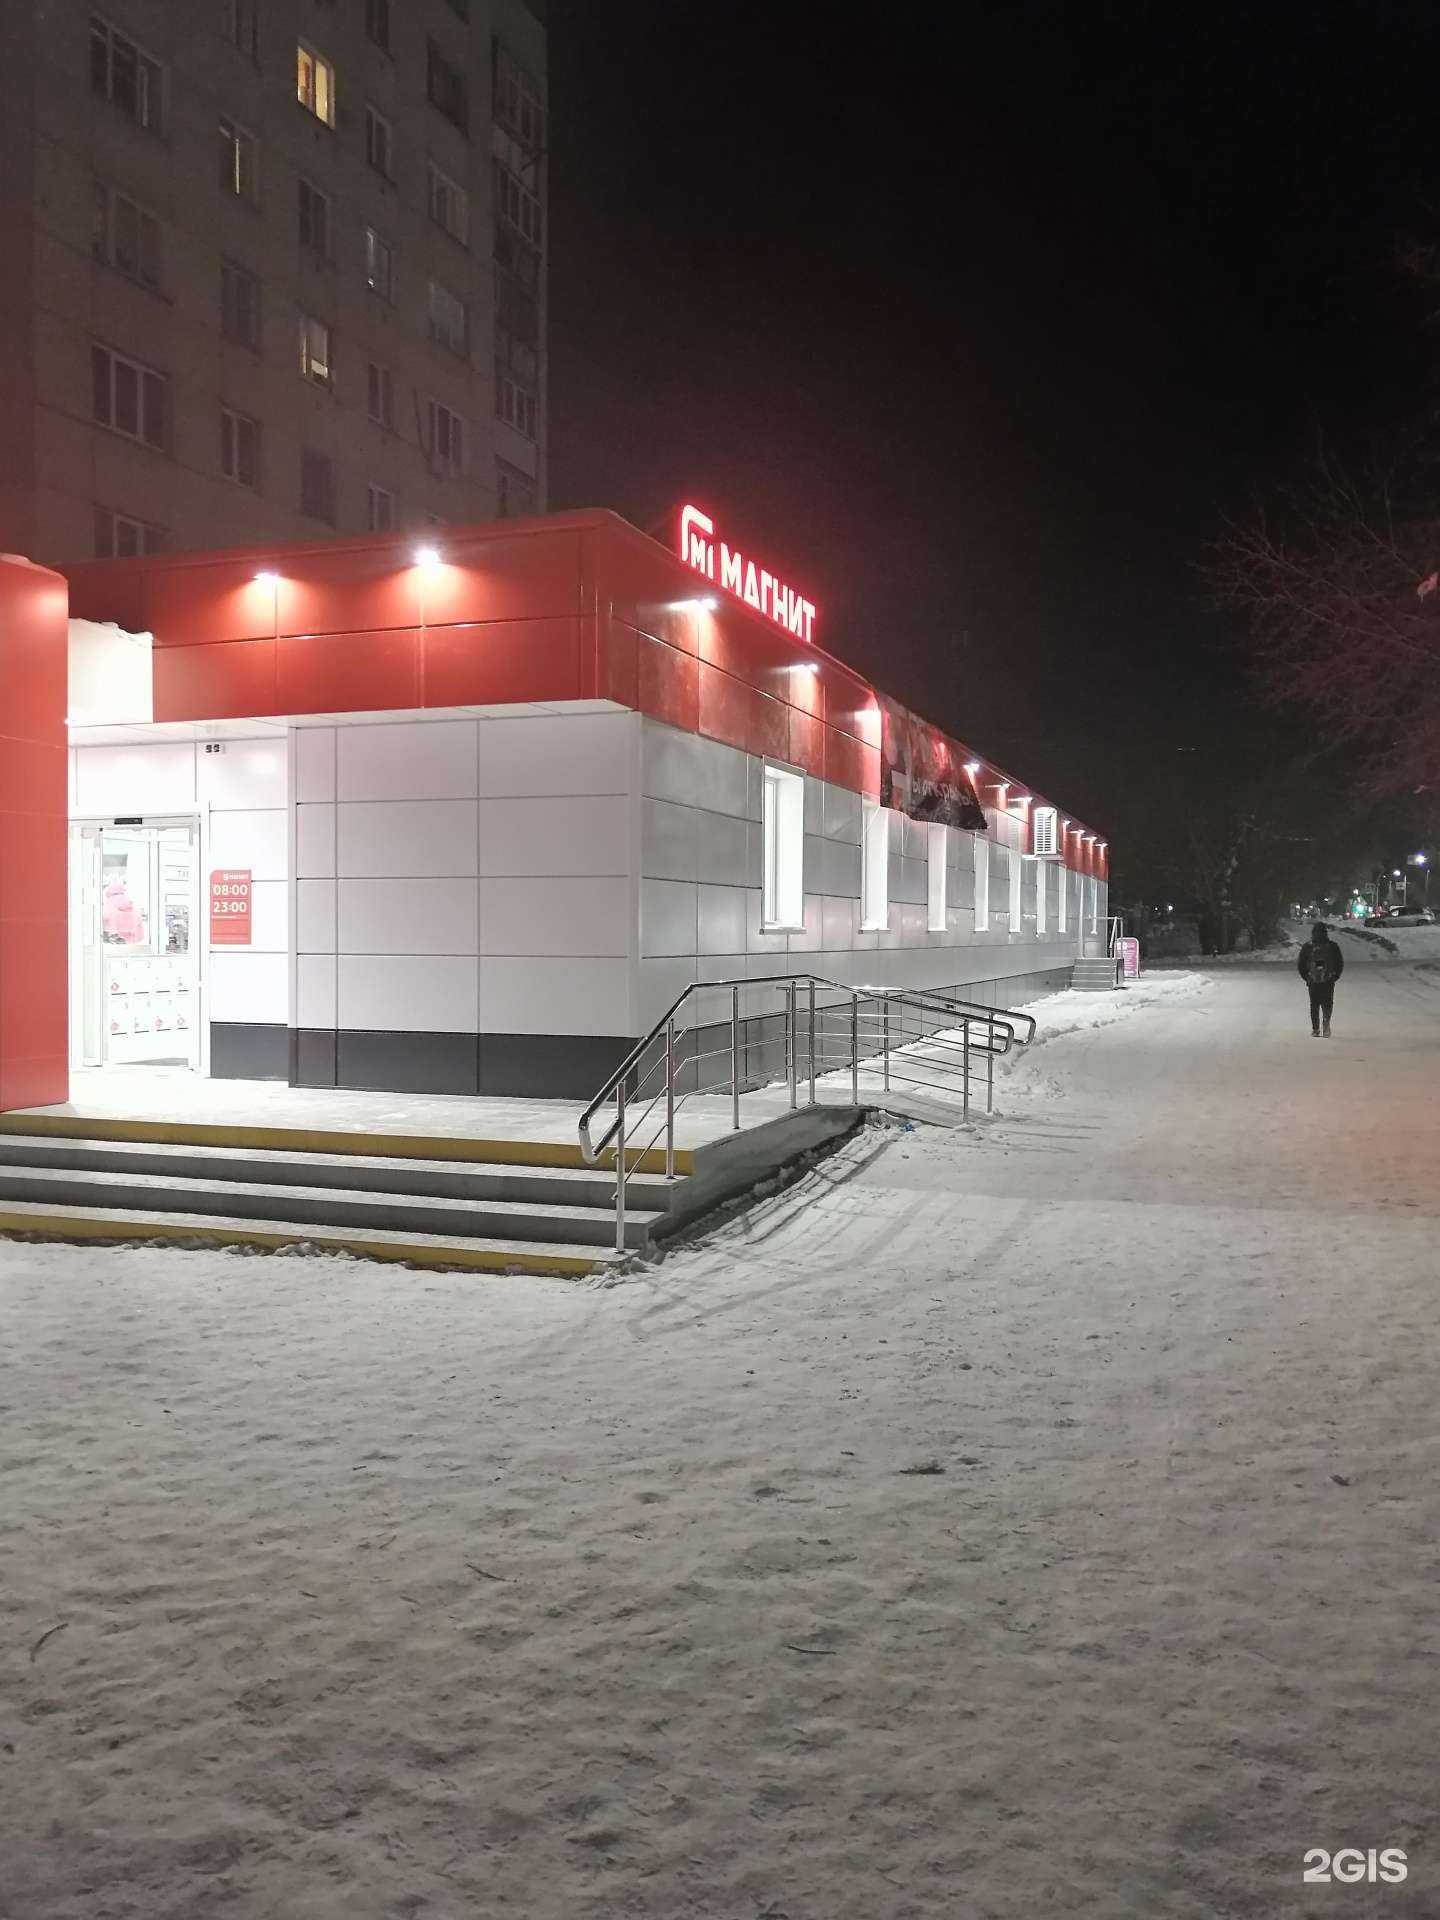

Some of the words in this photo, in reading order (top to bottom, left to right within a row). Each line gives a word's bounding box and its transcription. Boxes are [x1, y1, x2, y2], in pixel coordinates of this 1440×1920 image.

[720, 542, 816, 644] МАГНИТ
[213, 883, 248, 897] 08:00
[213, 901, 247, 913] 23:00
